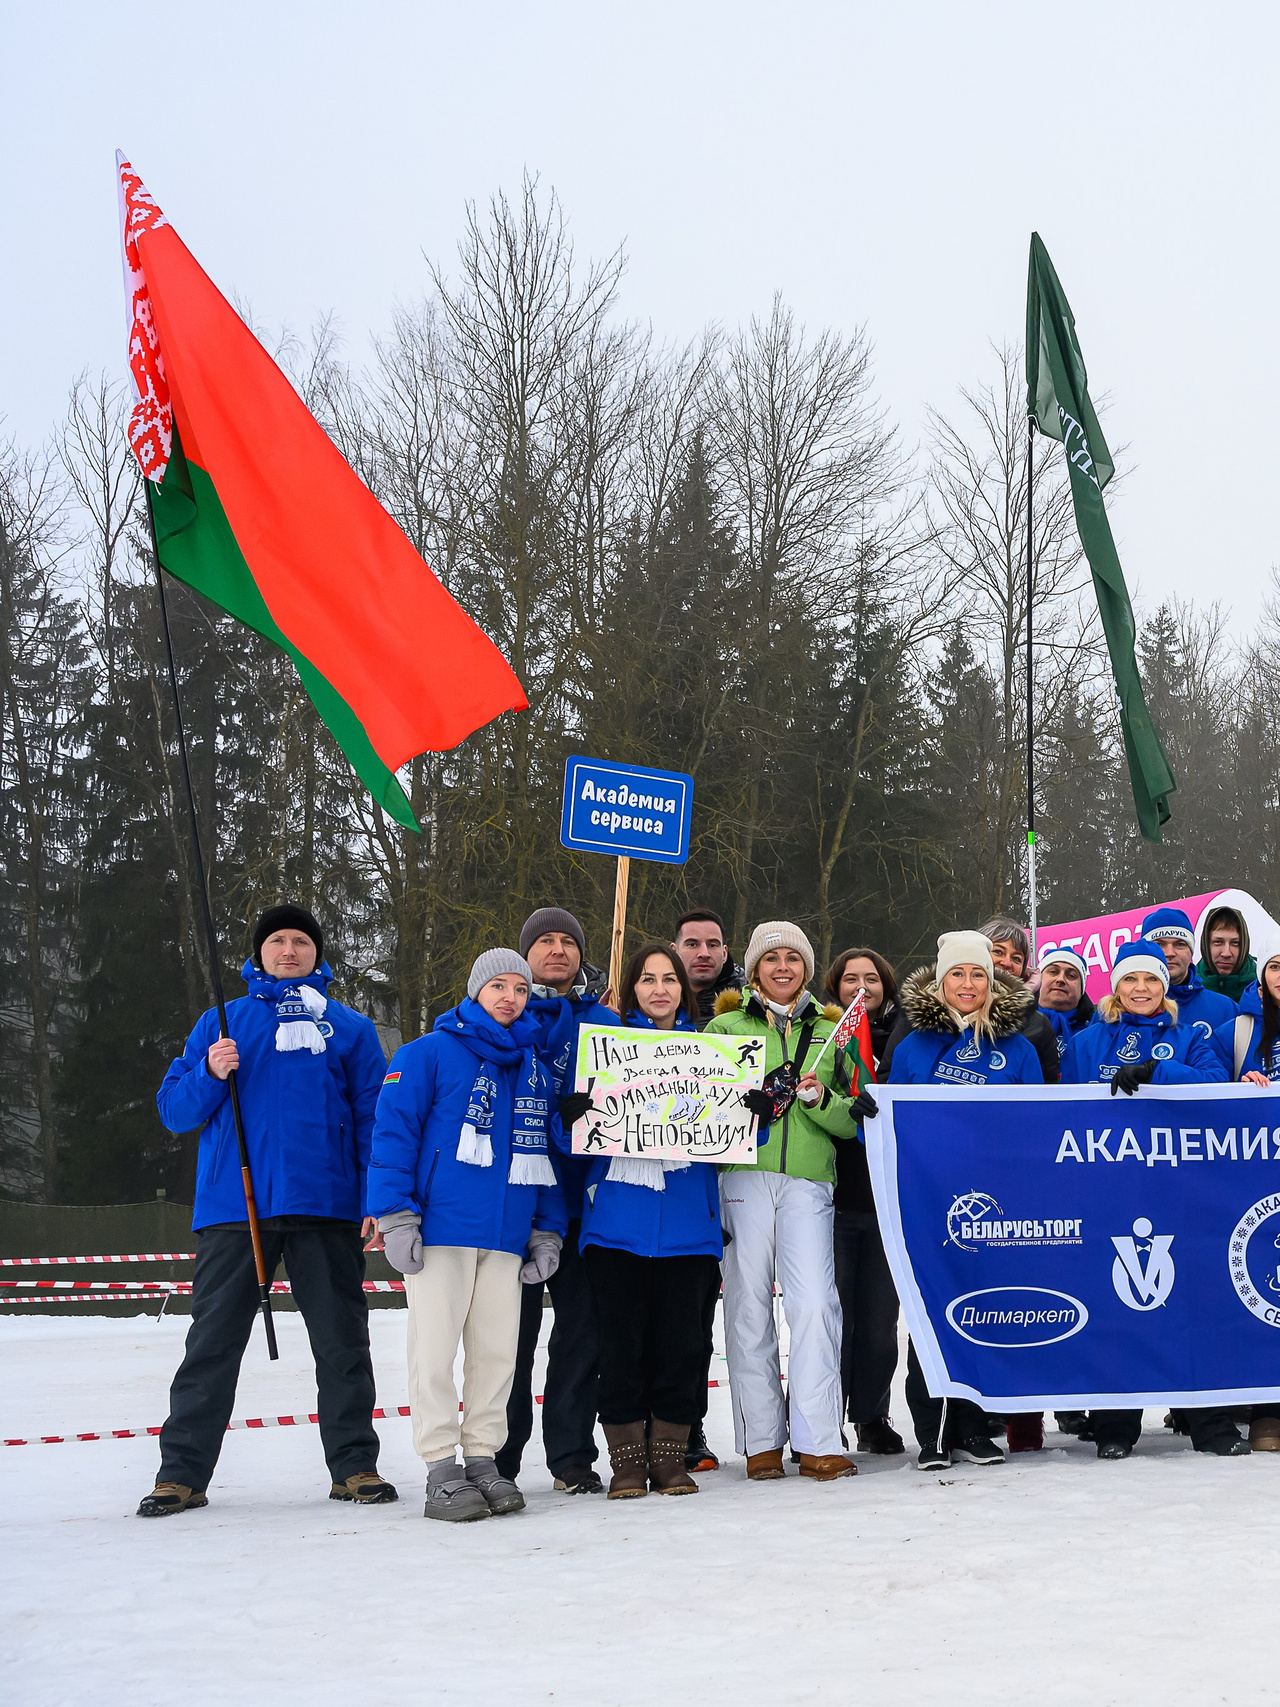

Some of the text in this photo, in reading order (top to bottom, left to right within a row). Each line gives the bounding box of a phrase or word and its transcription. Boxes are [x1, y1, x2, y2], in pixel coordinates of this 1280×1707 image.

[581, 779, 676, 814] Академия
[590, 809, 664, 836] сервиса
[961, 1218, 1083, 1240] БЕЛАРУСЬТОРГ
[986, 1238, 1083, 1248] ГОСУДАРСТВЕННОЕ ПРЕДПРИЯТИЕ
[960, 1306, 1076, 1328] Дипмаркет
